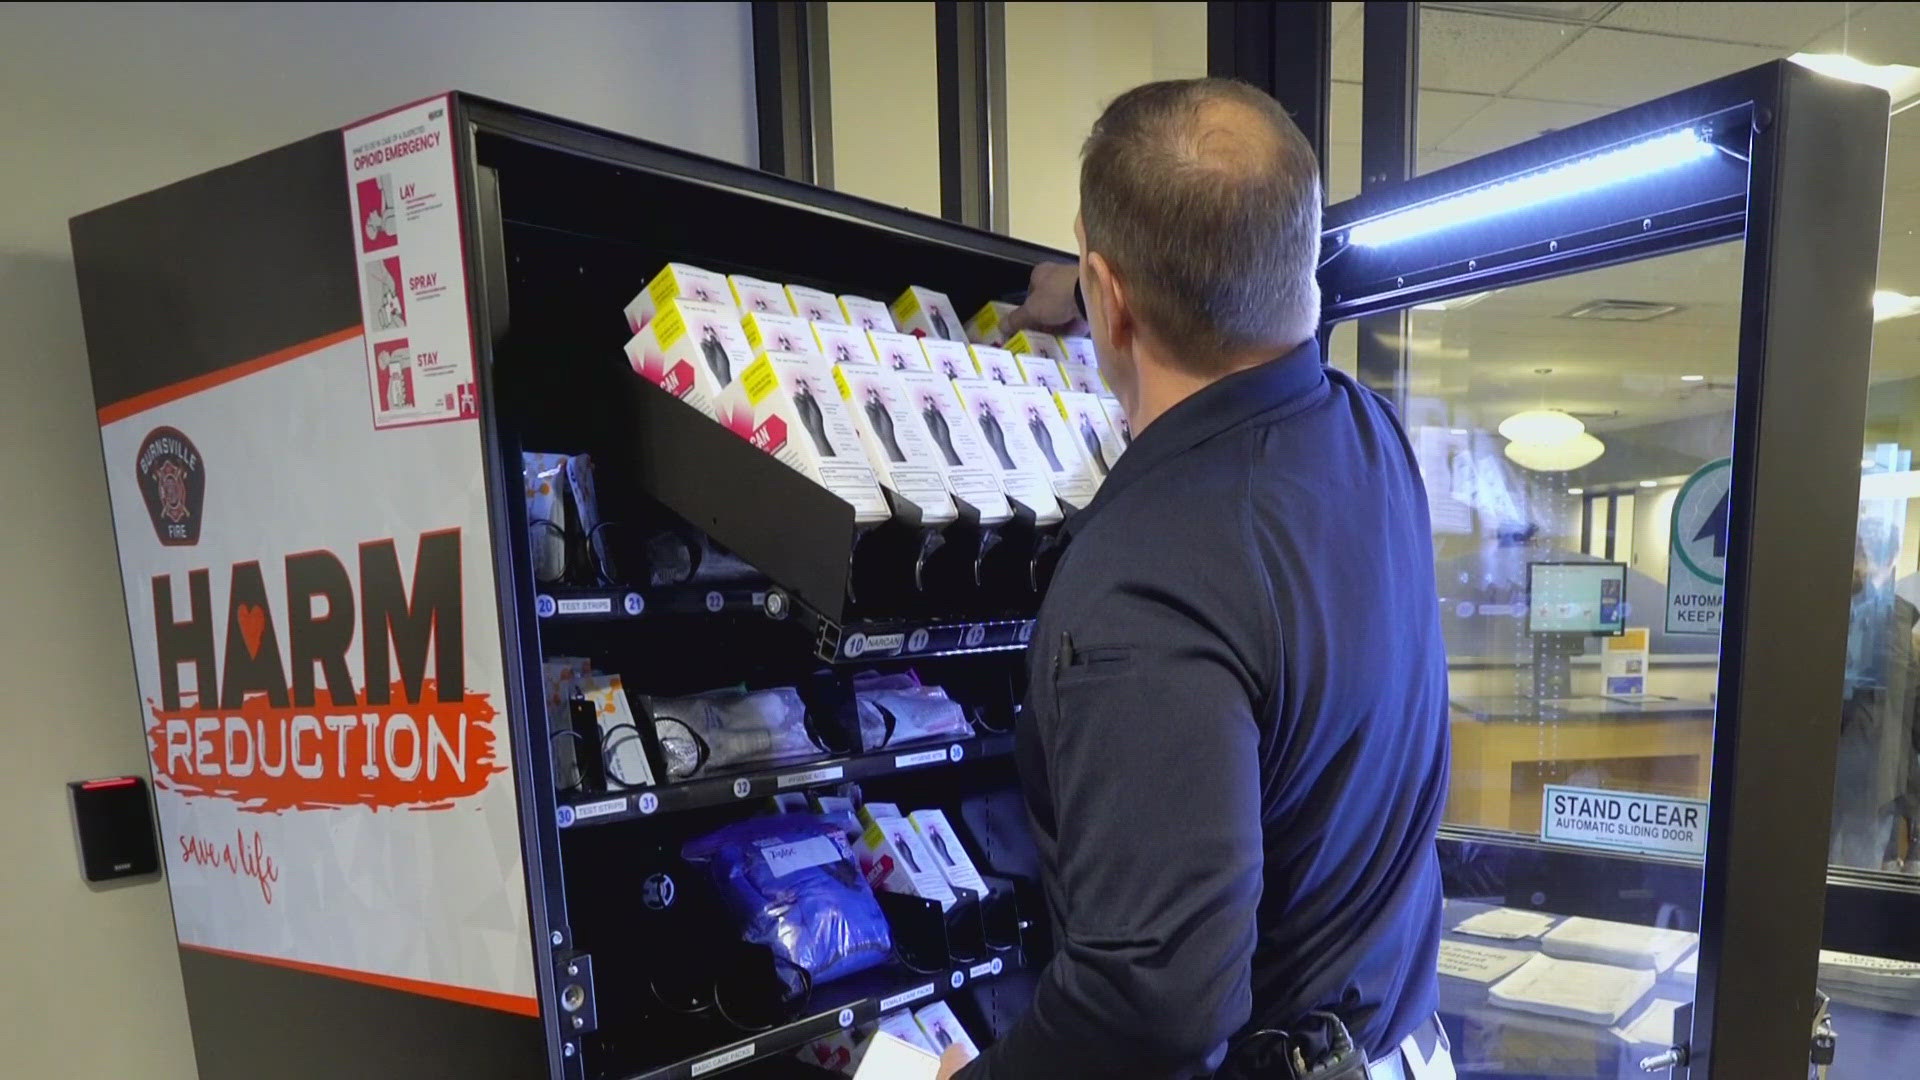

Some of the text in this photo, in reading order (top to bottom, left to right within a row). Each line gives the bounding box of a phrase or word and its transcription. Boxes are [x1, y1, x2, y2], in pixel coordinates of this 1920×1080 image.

[354, 131, 440, 171] OPIOID EMERGENCY
[399, 182, 415, 200] LAY
[409, 272, 437, 291] SPRAY
[417, 351, 438, 367] STAY
[140, 437, 197, 475] BURNSVILLE
[168, 524, 187, 538] FIRE
[539, 595, 721, 612] 20 TEST STRIPS 21 22
[1677, 610, 1715, 622] KEEP
[151, 527, 465, 713] HARM
[850, 638, 864, 653] 10
[868, 637, 900, 648] NARCAN
[913, 634, 926, 648] 11
[165, 713, 468, 783] REDUCTION
[558, 810, 572, 823] 30
[580, 806, 597, 816] TEST
[598, 801, 625, 813] STRIPS
[643, 797, 655, 810] 31
[736, 781, 749, 794] 32
[1554, 795, 1698, 828] STAND CLEAR
[1556, 817, 1615, 834] AUTOMATIC
[1618, 823, 1659, 839] SLIDING
[1662, 828, 1693, 842] DOOR
[180, 828, 278, 904] save a life
[693, 1061, 712, 1074] BASIC
[713, 1055, 730, 1066] CARE
[731, 1047, 753, 1060] PACKS
[883, 996, 902, 1008] FEMALE
[903, 992, 916, 1001] CARE
[917, 987, 933, 997] PACKS
